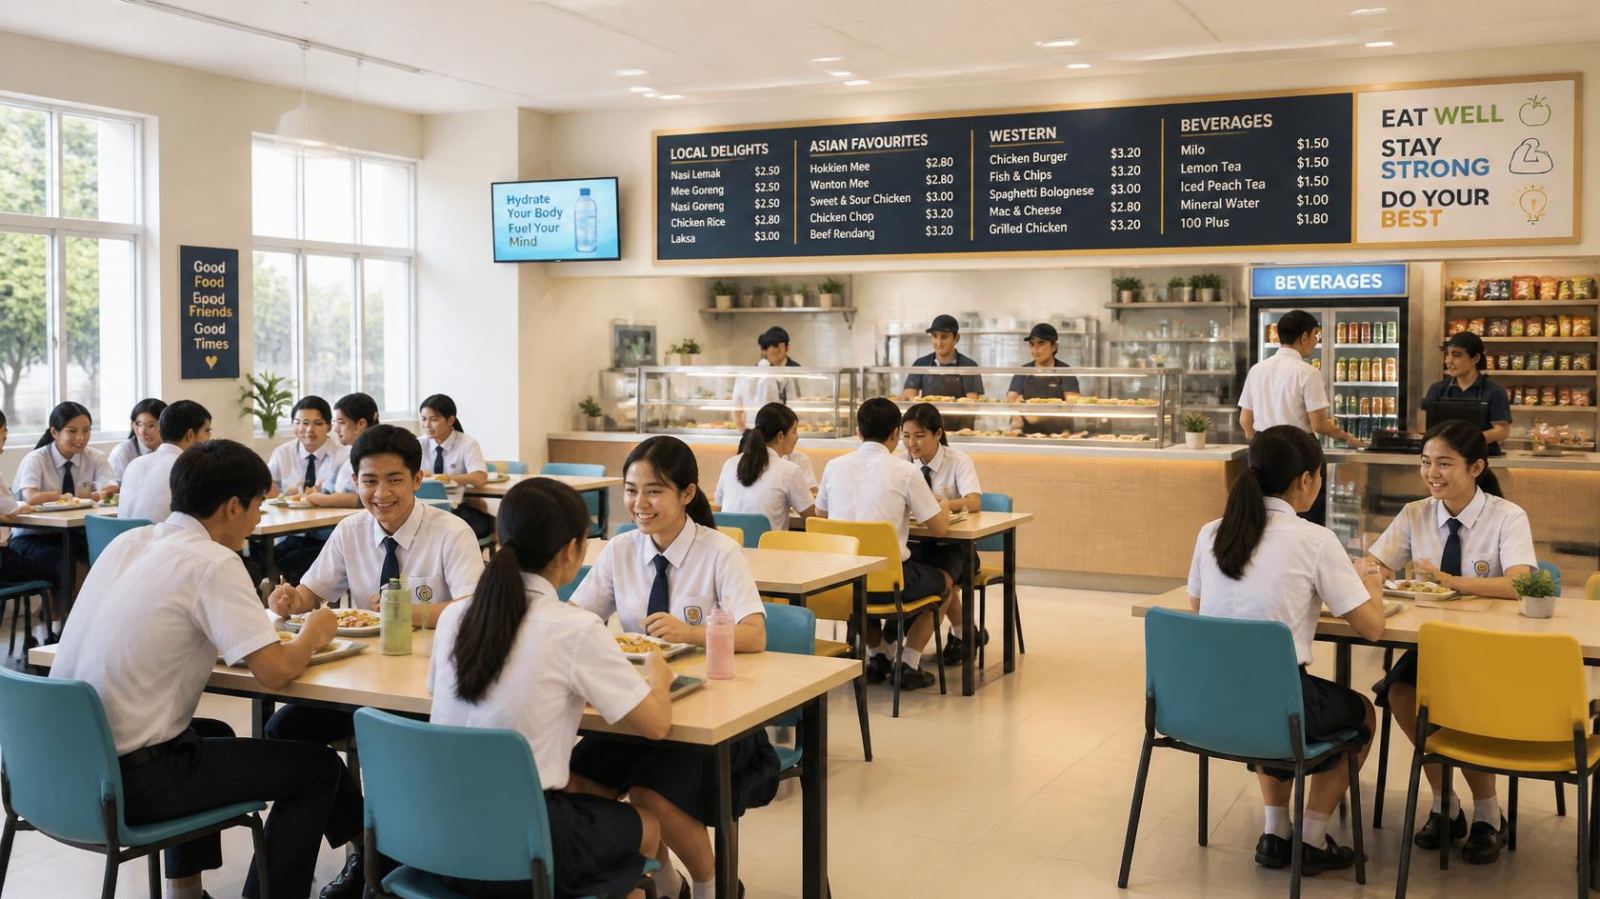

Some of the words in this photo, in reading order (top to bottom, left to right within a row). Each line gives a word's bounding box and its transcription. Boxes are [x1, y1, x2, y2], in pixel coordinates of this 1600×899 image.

[1383, 108, 1428, 128] EAT
[1434, 104, 1504, 125] WELL
[1181, 114, 1272, 132] BEVERAGES
[990, 127, 1057, 143] WESTERN
[810, 138, 847, 152] ASIAN
[852, 134, 927, 149] FAVOURITES
[1298, 138, 1328, 150] $1.50
[1382, 137, 1442, 157] STAY
[671, 147, 707, 159] LOCAL
[711, 143, 768, 157] DELIGHTS
[1111, 147, 1140, 159] $3.20
[1181, 145, 1205, 155] Milo
[926, 157, 953, 168] $2.80
[990, 154, 1030, 164] Chicken
[1033, 152, 1067, 164] Burger
[1297, 157, 1328, 169] $1.50
[755, 166, 779, 176] $2.50
[810, 163, 847, 173] Hokkien
[850, 162, 870, 171] Mee
[1111, 165, 1140, 177] $3.20
[1181, 162, 1218, 173] Lemon
[1221, 161, 1241, 172] Tea
[1382, 158, 1489, 179] STRONG
[671, 171, 690, 180] Nasi
[692, 169, 720, 179] Lemak
[926, 174, 953, 185] $2.80
[990, 171, 1010, 182] Fish
[1013, 171, 1020, 181] &
[1024, 170, 1052, 182] Chips
[755, 182, 779, 192] $2.50
[810, 180, 846, 189] Wanton
[850, 179, 869, 188] Mee
[1181, 180, 1204, 192] Iced
[1208, 179, 1242, 191] Peach
[1245, 179, 1265, 190] Tea
[1297, 175, 1328, 188] $1.50
[671, 187, 690, 195] Mee
[692, 186, 724, 196] Goreng
[990, 187, 1037, 201] Spaghetti
[1041, 186, 1094, 198] Bolognese
[1111, 184, 1141, 195] $3.00
[507, 195, 550, 206] Hydrate
[810, 197, 838, 206] Sweet
[841, 195, 847, 205] &
[850, 195, 871, 205] Sour
[873, 194, 911, 204] Chicken
[926, 192, 953, 202] $3.00
[1297, 194, 1328, 207] $1.00
[1382, 191, 1416, 208] DO
[1422, 189, 1489, 206] YOUR
[671, 202, 690, 211] Nasi
[692, 202, 724, 212] Goreng
[755, 199, 779, 209] $2.50
[1111, 202, 1140, 213] $2.80
[1181, 198, 1222, 210] Mineral
[1225, 198, 1260, 209] Water
[508, 208, 532, 218] Your
[535, 207, 563, 220] Body
[926, 209, 953, 219] $3.20
[990, 207, 1010, 217] Mac
[1013, 206, 1021, 216] &
[1024, 205, 1061, 215] Cheese
[671, 218, 705, 227] Chicken
[708, 217, 725, 226] Rice
[755, 215, 780, 226] $2.80
[810, 213, 846, 223] Chicken
[849, 212, 874, 223] Chop
[1181, 218, 1201, 228] 100
[1205, 217, 1229, 228] Plus
[1297, 213, 1328, 225] $1.80
[1382, 209, 1442, 228] BEST
[509, 223, 532, 233] Fuel
[534, 223, 559, 233] Your
[926, 225, 953, 236] $3.20
[990, 223, 1023, 234] Grilled
[1026, 222, 1067, 233] Chicken
[1111, 220, 1140, 231] $3.20
[671, 234, 695, 243] Laksa
[755, 231, 779, 242] $3.00
[811, 229, 831, 239] Beef
[834, 228, 874, 240] Rendang
[510, 236, 537, 247] Mind
[194, 261, 225, 275] Good
[195, 275, 224, 288] Food
[1275, 274, 1382, 290] BEVERAGES
[189, 304, 232, 317] Friends
[194, 323, 225, 334] Good
[194, 337, 228, 349] Times
